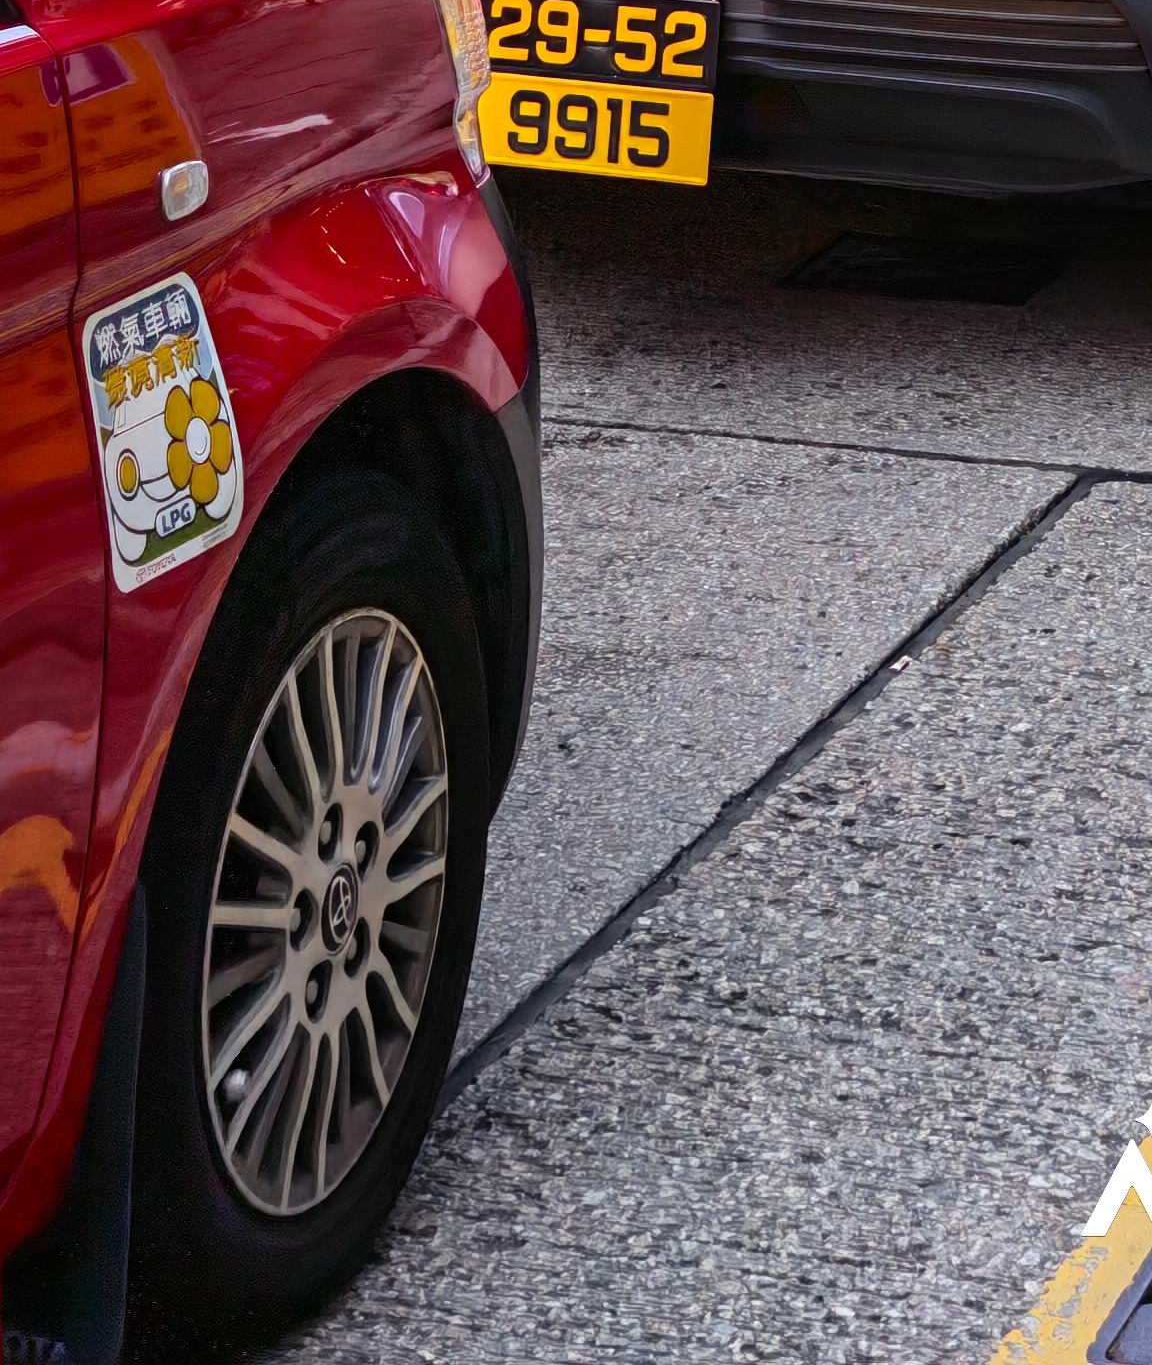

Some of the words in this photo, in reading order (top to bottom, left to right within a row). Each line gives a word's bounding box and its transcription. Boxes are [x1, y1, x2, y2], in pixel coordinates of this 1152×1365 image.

[506, 89, 671, 168] 9915
[93, 287, 193, 370] 燃氣車輛
[160, 501, 191, 533] LPG
